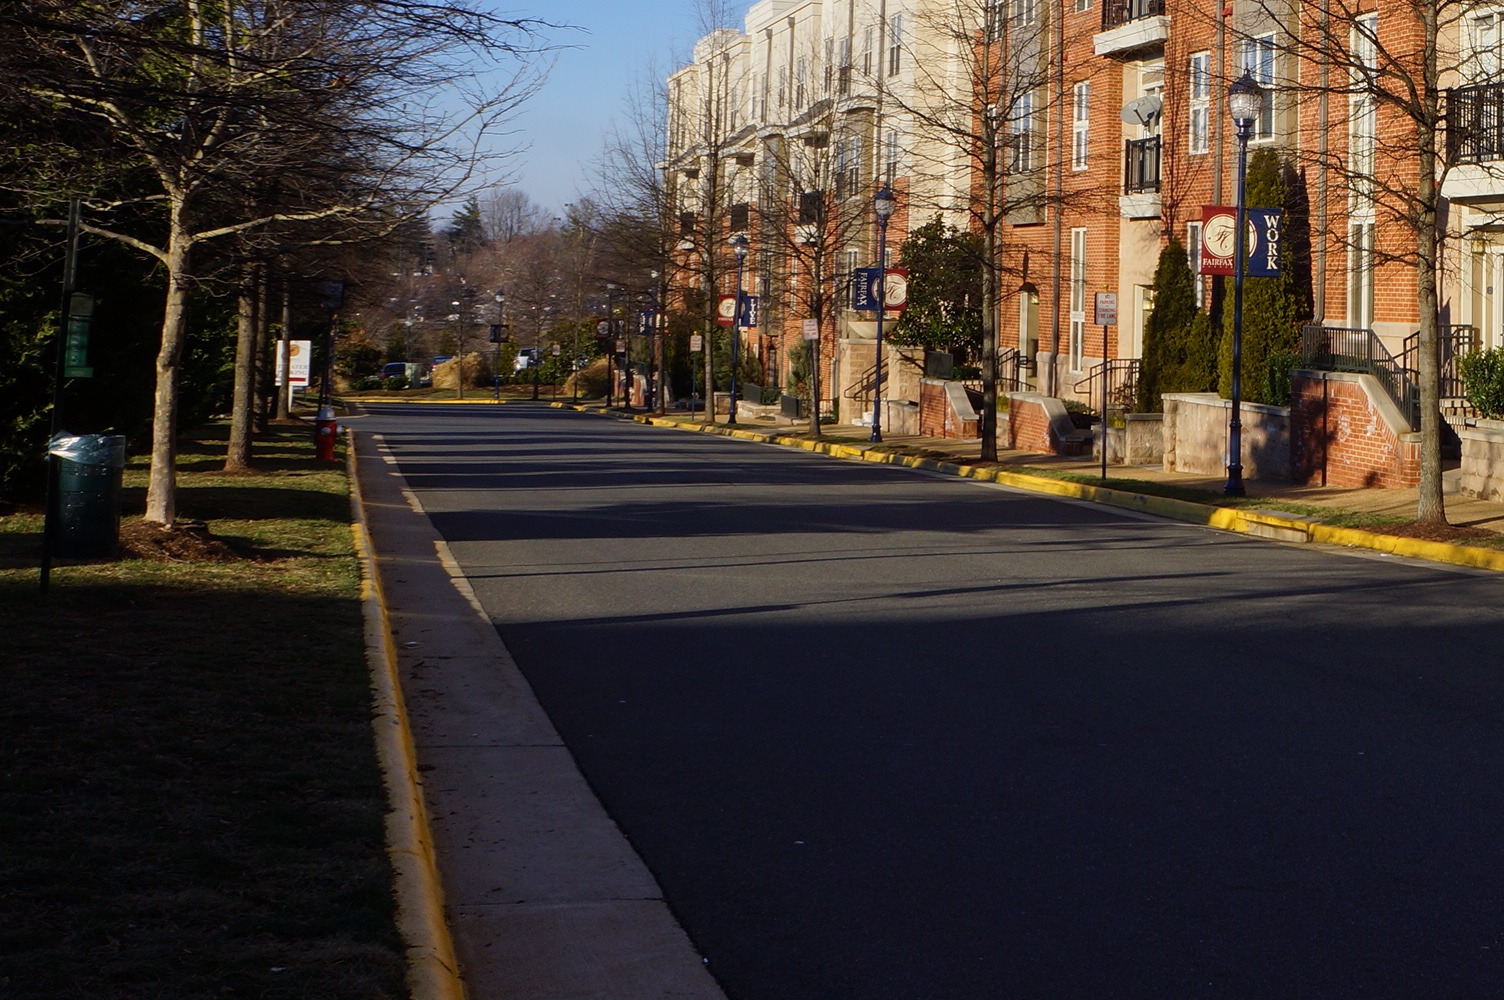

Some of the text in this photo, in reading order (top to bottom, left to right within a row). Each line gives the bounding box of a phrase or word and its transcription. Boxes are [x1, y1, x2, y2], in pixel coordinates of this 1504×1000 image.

[1263, 215, 1280, 270] WORK
[1202, 258, 1233, 266] FAIRFAX
[859, 272, 868, 305] FAIRFAX
